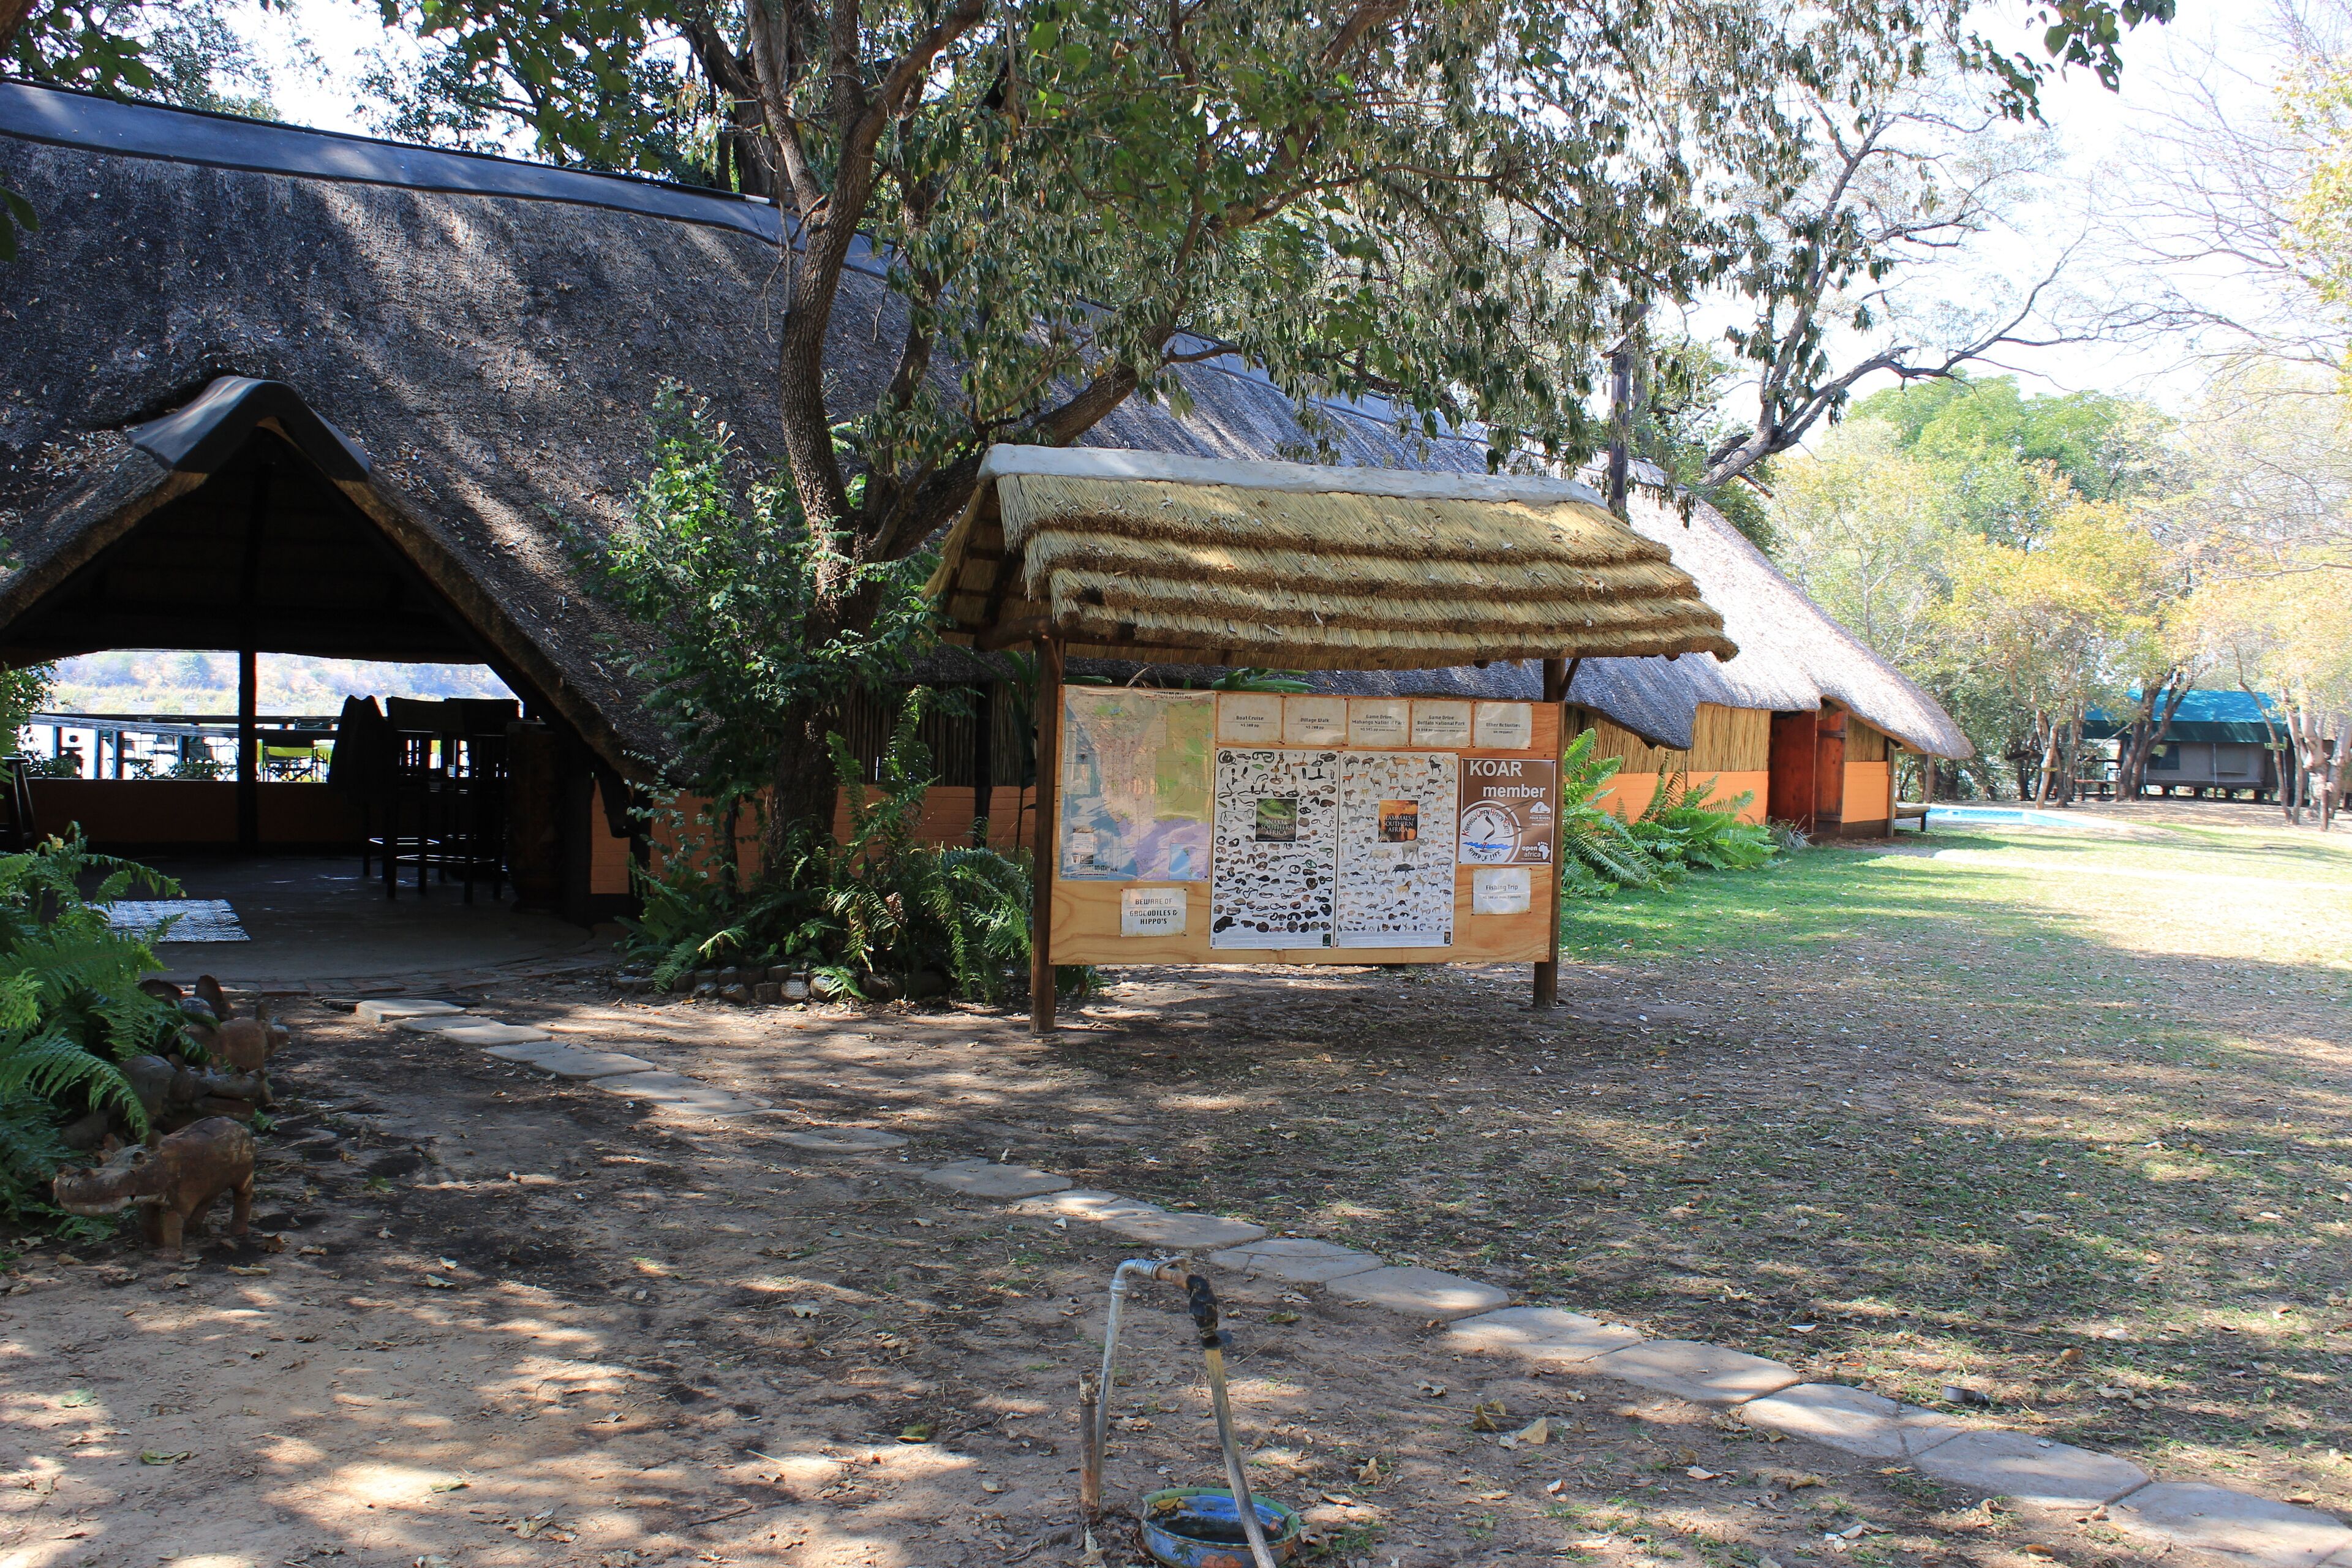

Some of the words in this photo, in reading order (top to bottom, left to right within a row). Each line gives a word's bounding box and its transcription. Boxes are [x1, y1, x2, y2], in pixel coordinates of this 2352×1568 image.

[1470, 760, 1523, 777] KOAR
[1483, 784, 1546, 798] member
[1476, 809, 1490, 818] OPEN
[1468, 848, 1481, 860] RIVER
[1490, 850, 1502, 861] LIFE
